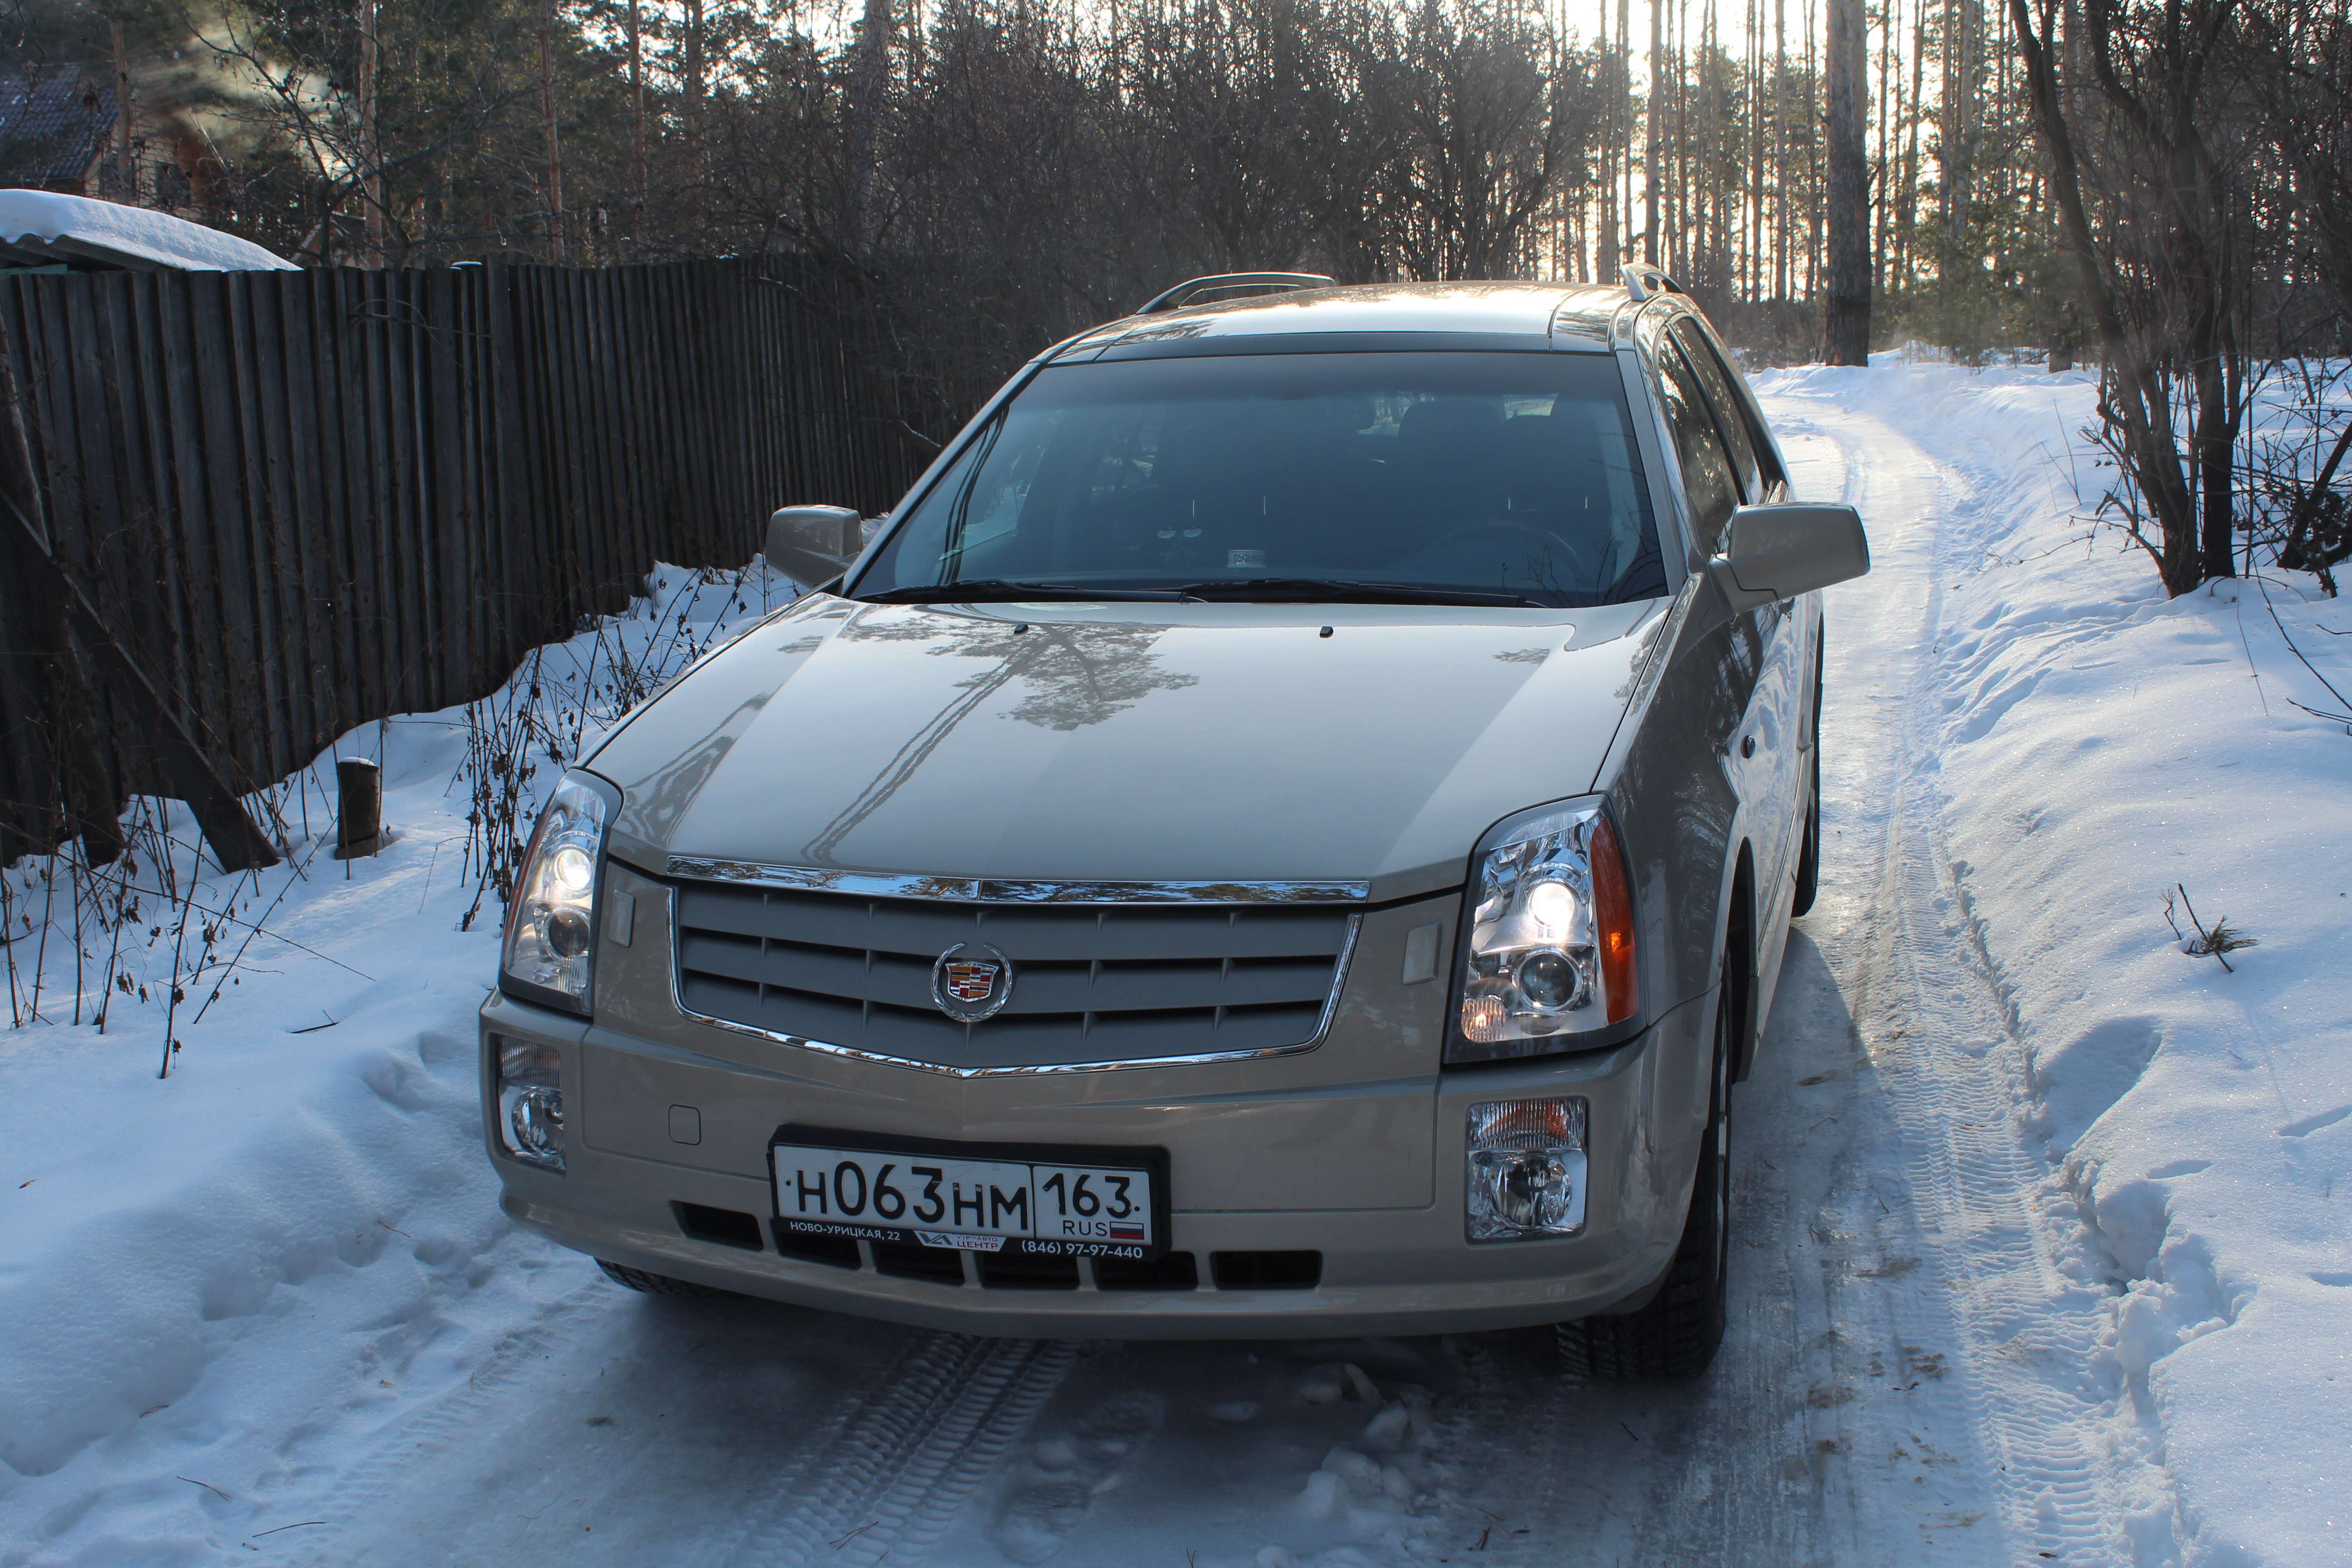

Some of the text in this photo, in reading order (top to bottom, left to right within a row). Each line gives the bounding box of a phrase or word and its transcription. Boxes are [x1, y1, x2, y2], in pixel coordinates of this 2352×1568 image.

[1042, 1173, 1132, 1219] 163
[887, 1231, 901, 1240] 22
[1063, 1220, 1107, 1236] RUS
[957, 1240, 998, 1249] ЦЕНТР
[1022, 1240, 1143, 1258] (846) 97-97-440
